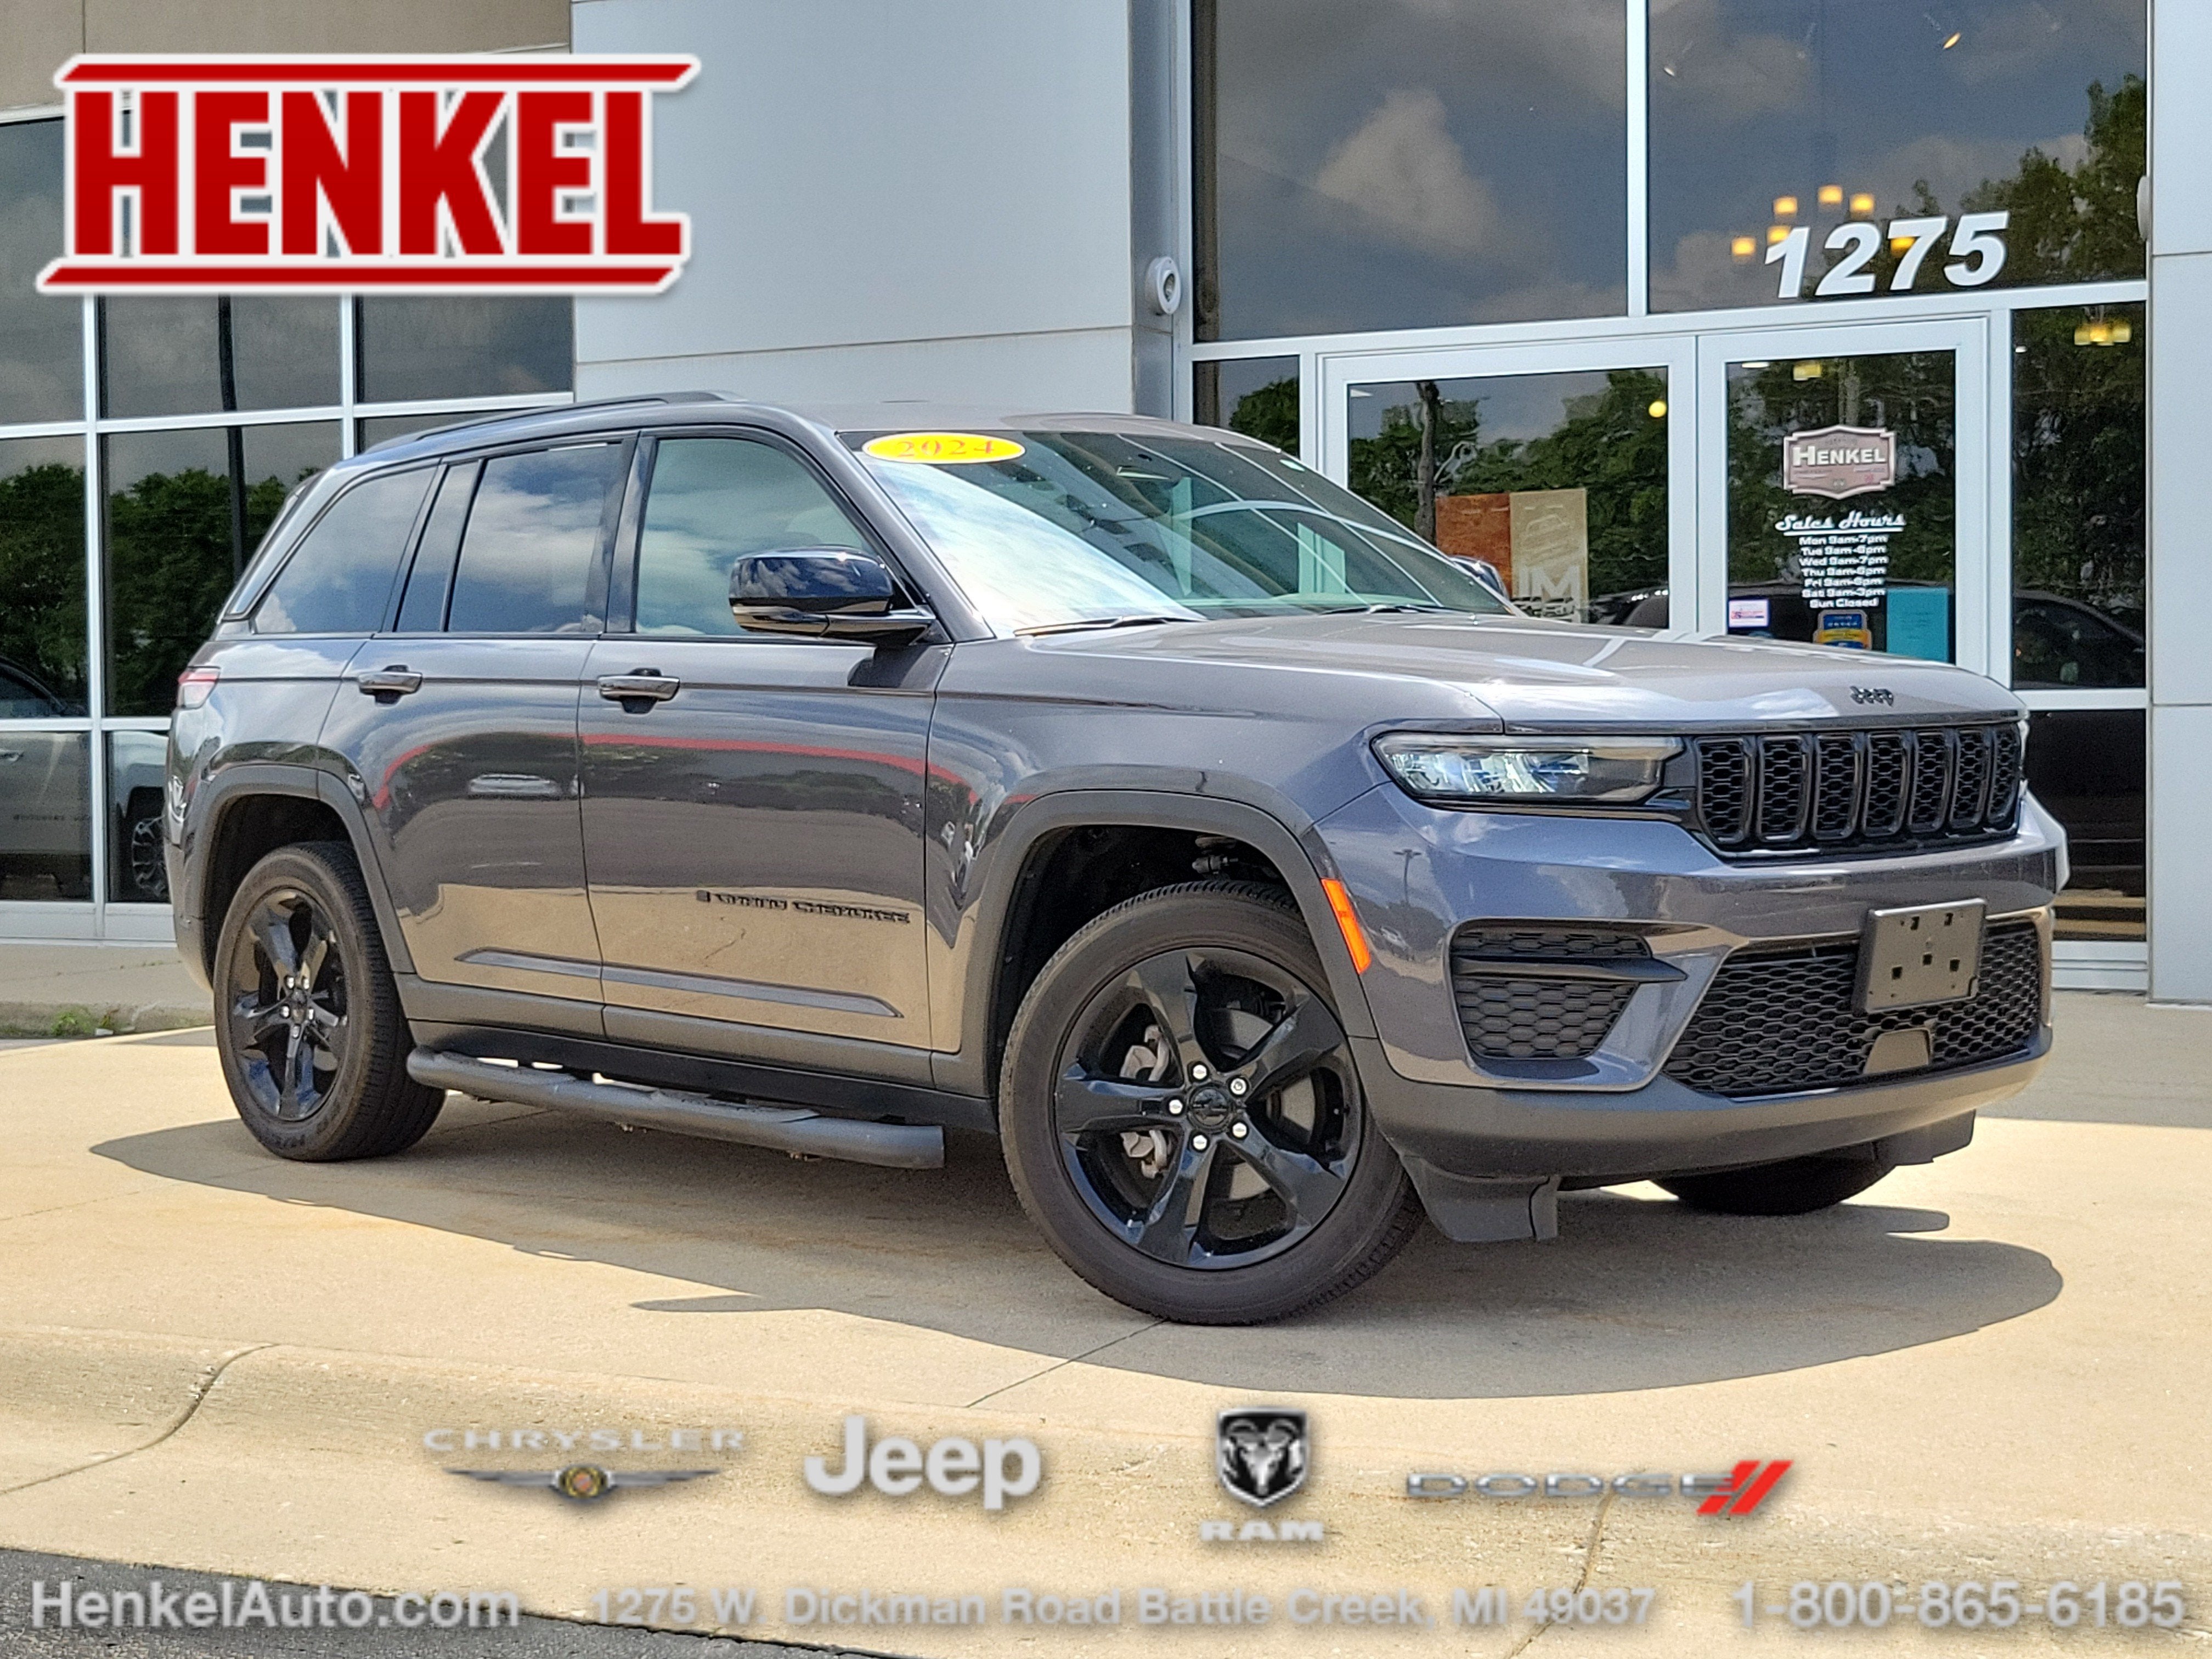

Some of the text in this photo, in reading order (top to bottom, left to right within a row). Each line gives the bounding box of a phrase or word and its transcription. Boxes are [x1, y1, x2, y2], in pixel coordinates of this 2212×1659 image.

[1764, 210, 2010, 298] 1275
[896, 439, 995, 458] 2024
[1792, 445, 1886, 466] HENKEL
[1775, 510, 1906, 531] Sales Hours
[1799, 537, 1827, 545] Mon
[1798, 557, 1827, 566] Wed
[1801, 568, 1825, 577] Thu
[1801, 589, 1825, 598] Sat
[1809, 597, 1880, 608] Sun Closed
